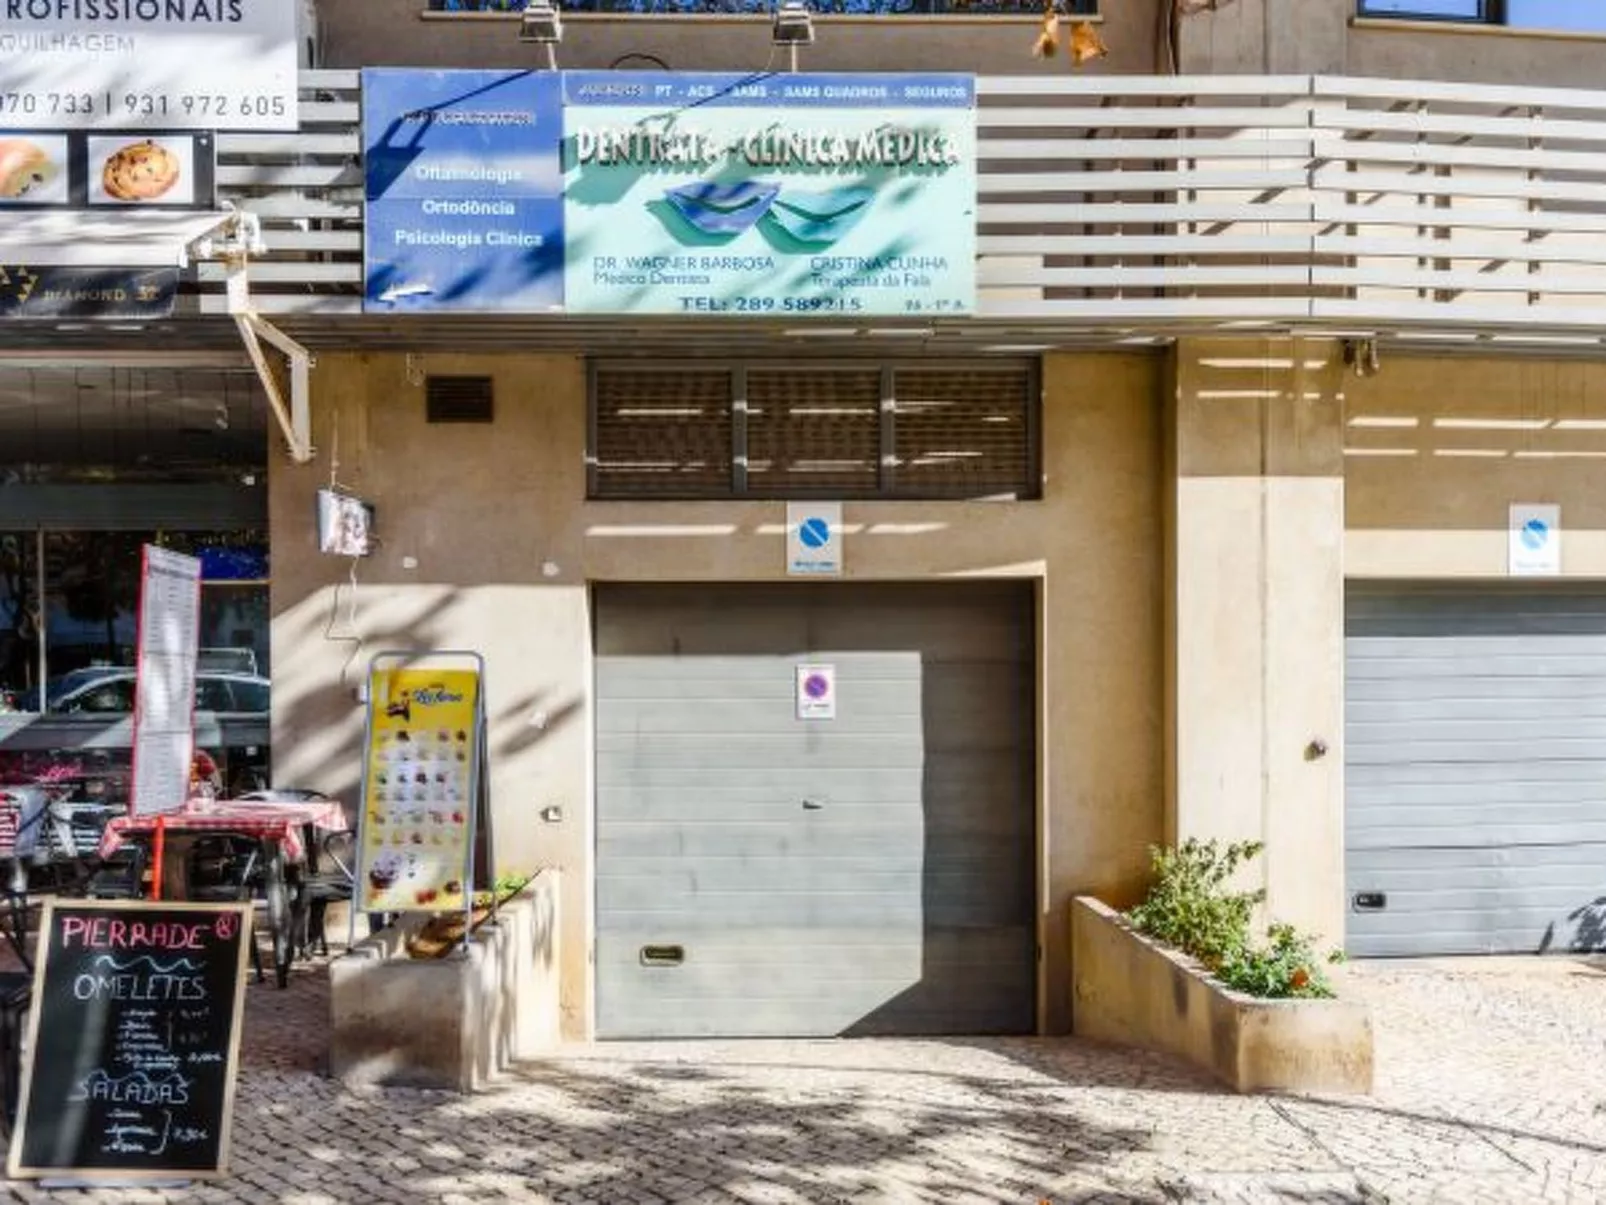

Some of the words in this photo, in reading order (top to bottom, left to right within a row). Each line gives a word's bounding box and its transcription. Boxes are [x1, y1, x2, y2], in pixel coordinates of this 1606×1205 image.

[48, 93, 93, 114] 733
[125, 93, 167, 115] 931
[181, 96, 227, 115] 972
[240, 96, 285, 115] 605
[395, 229, 482, 249] Psicologia
[626, 256, 697, 270] WAGNER
[700, 256, 775, 271] BARBOSA
[811, 256, 883, 271] CRISTINA
[888, 256, 948, 270] CUNHA
[735, 297, 774, 311] 289
[783, 297, 862, 311] 589215
[62, 915, 209, 949] PIERRADE
[74, 973, 206, 1001] OMELETES
[70, 1079, 190, 1105] SALADAS
